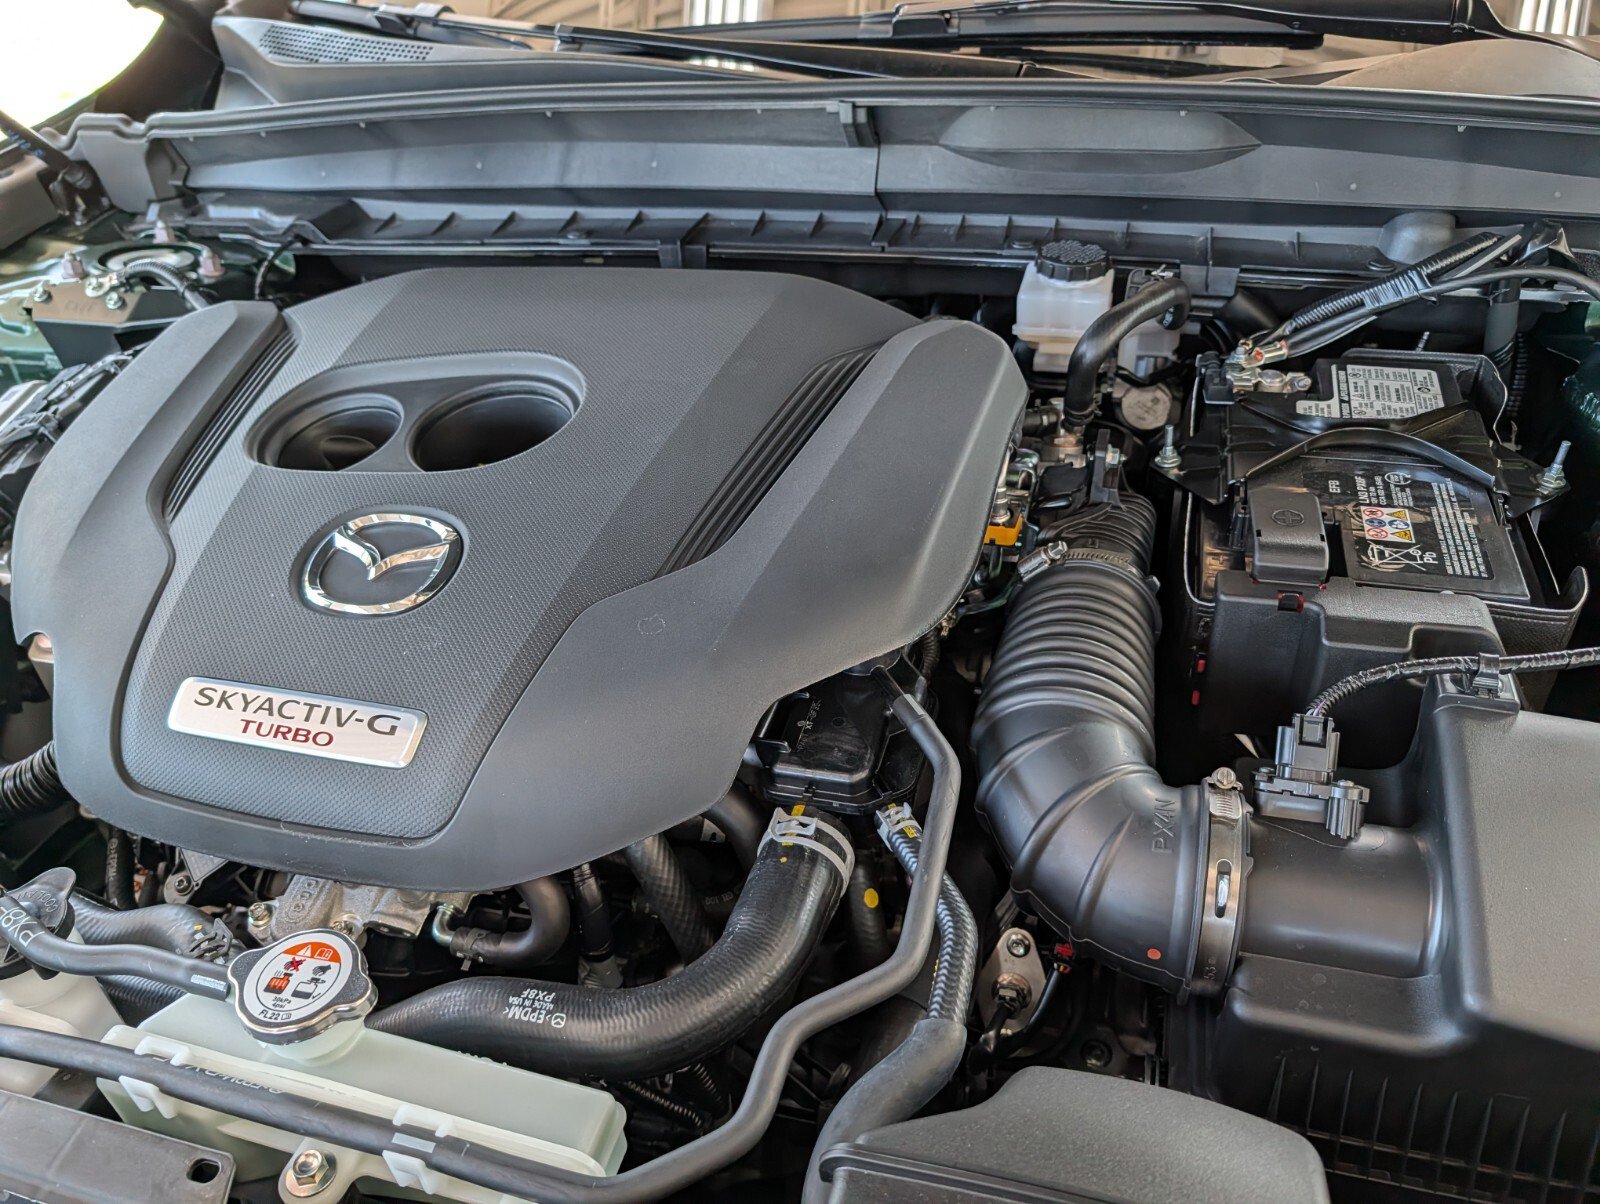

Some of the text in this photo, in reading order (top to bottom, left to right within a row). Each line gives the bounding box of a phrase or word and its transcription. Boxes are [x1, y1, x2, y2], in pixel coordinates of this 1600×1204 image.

[1328, 480, 1341, 493] EFB
[1423, 551, 1438, 564] Pb
[193, 686, 402, 736] SKYACTIV-G
[239, 719, 334, 747] TURBO
[520, 988, 556, 1003] PX8F
[523, 998, 532, 1007] IN
[258, 1009, 281, 1021] FL22
